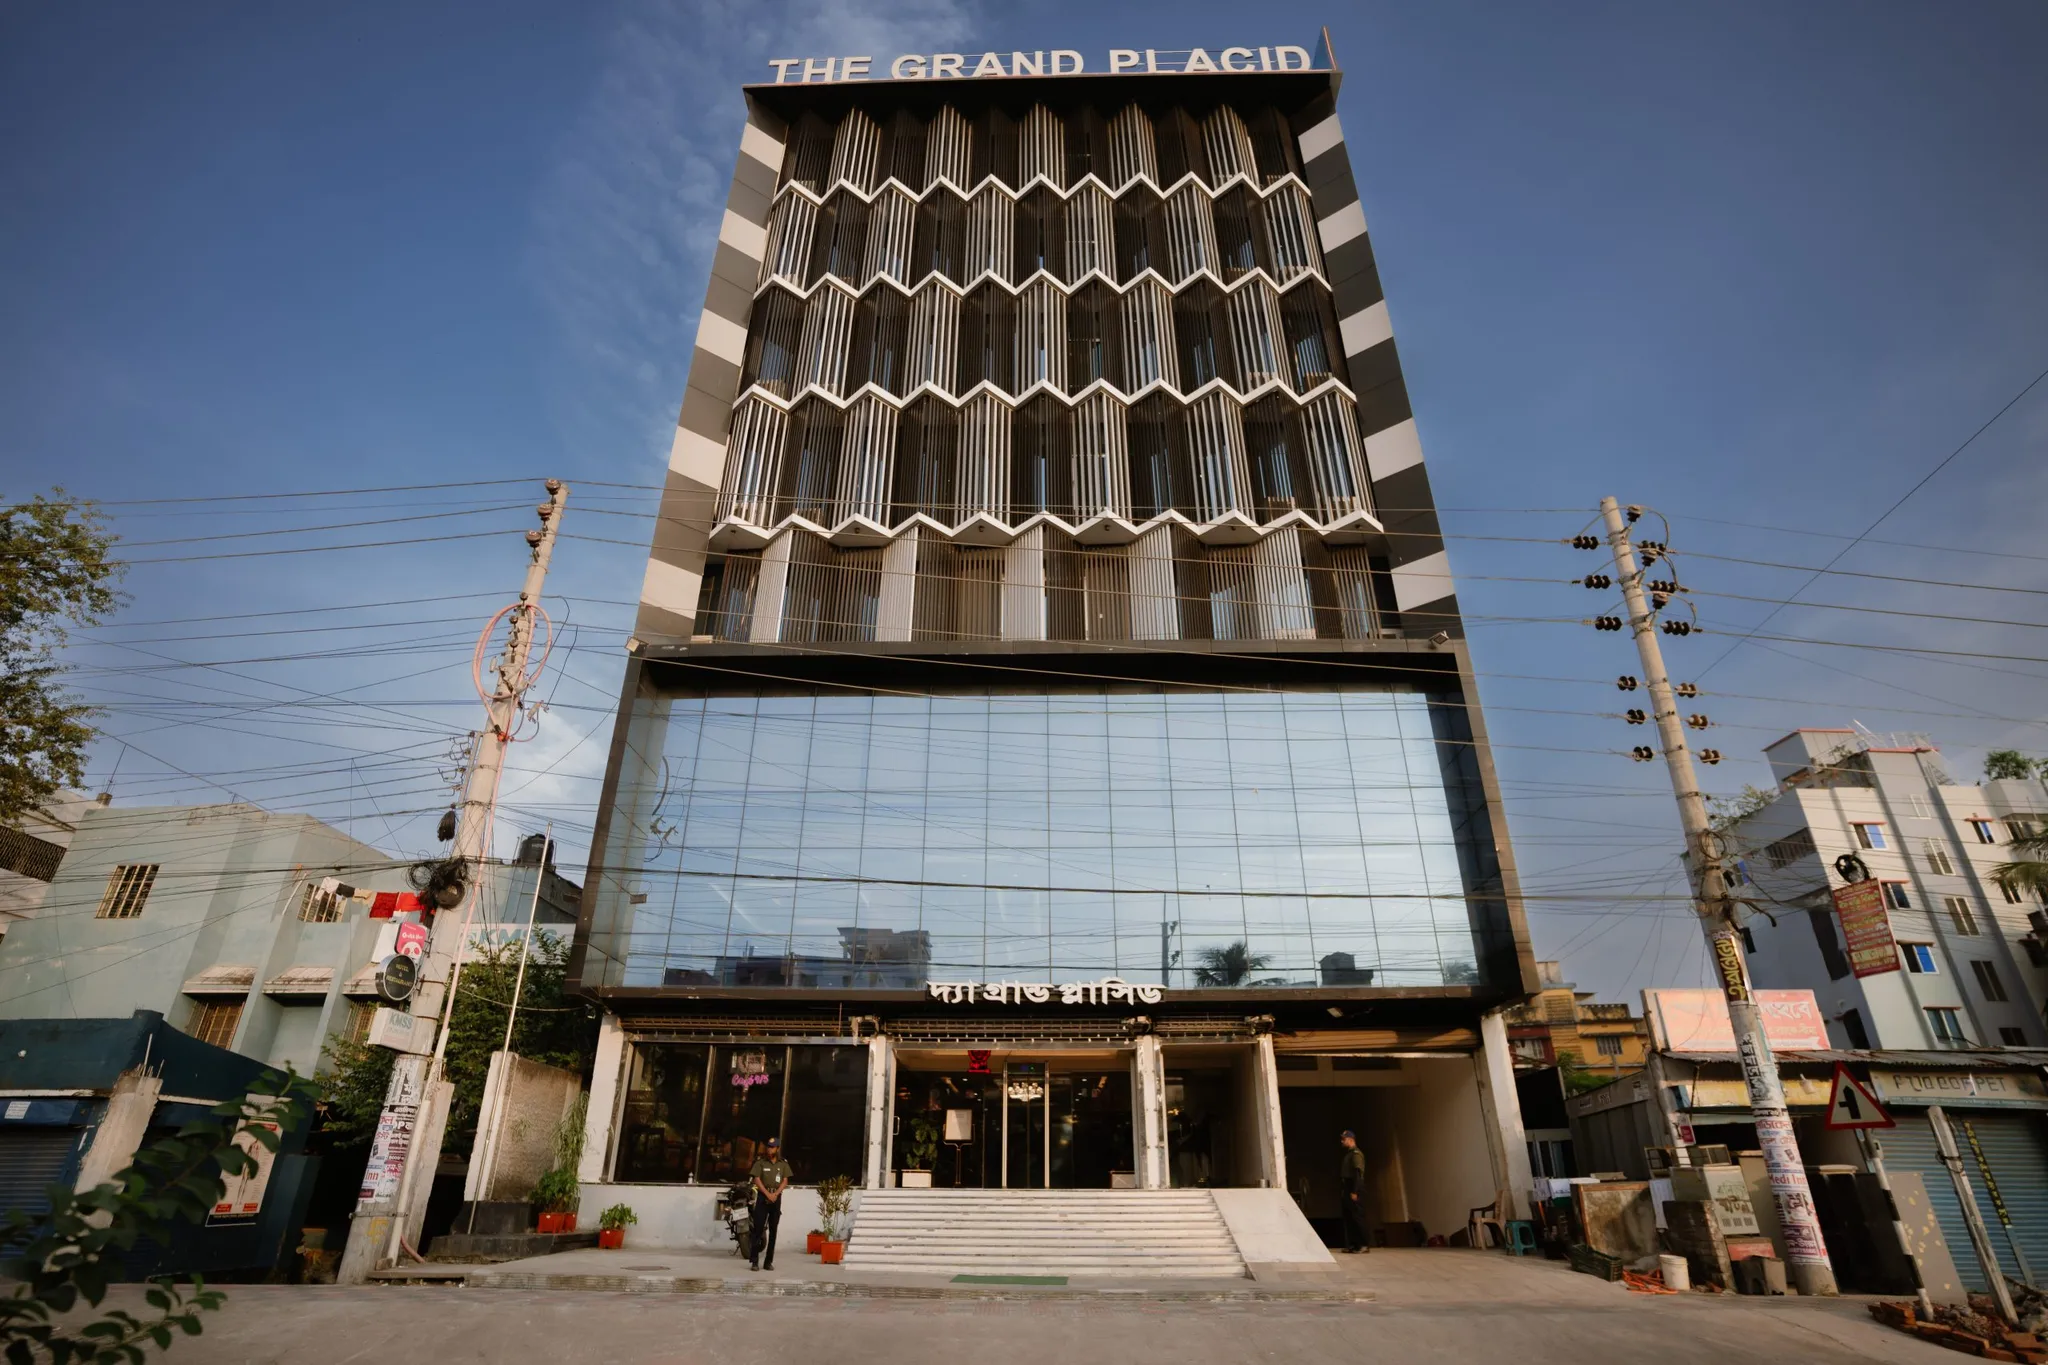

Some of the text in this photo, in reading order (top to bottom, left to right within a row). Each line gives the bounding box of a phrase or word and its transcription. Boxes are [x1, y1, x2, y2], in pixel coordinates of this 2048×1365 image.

[769, 44, 1312, 83] THE GRAND PLACID
[926, 979, 980, 1005] দ্যা
[1059, 976, 1167, 1005] প্লাসিড
